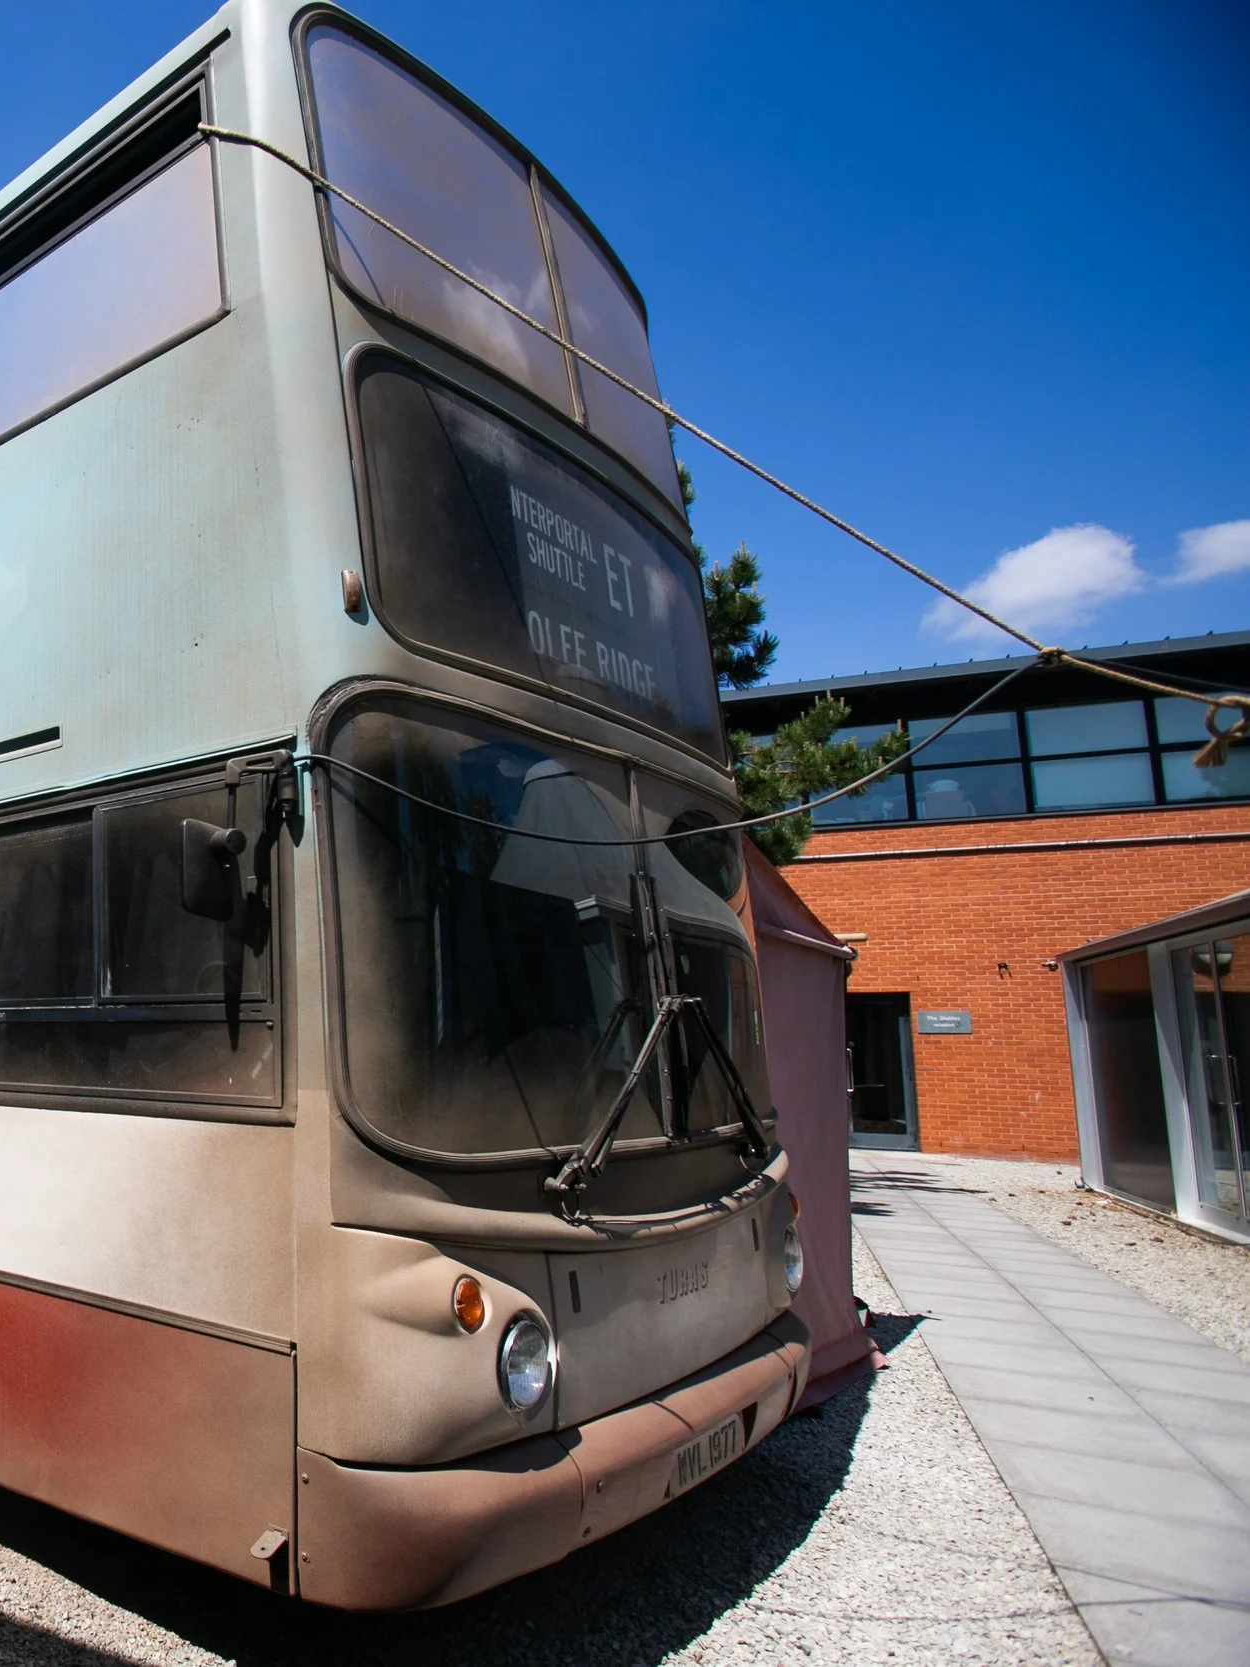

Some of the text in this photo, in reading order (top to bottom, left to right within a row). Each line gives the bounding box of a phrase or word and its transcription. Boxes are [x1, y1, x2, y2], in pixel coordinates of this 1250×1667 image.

[510, 485, 598, 565] NTERPORTAL
[527, 532, 586, 592] SHUTTLE
[602, 543, 634, 618] ET
[709, 1420, 736, 1468] 1977
